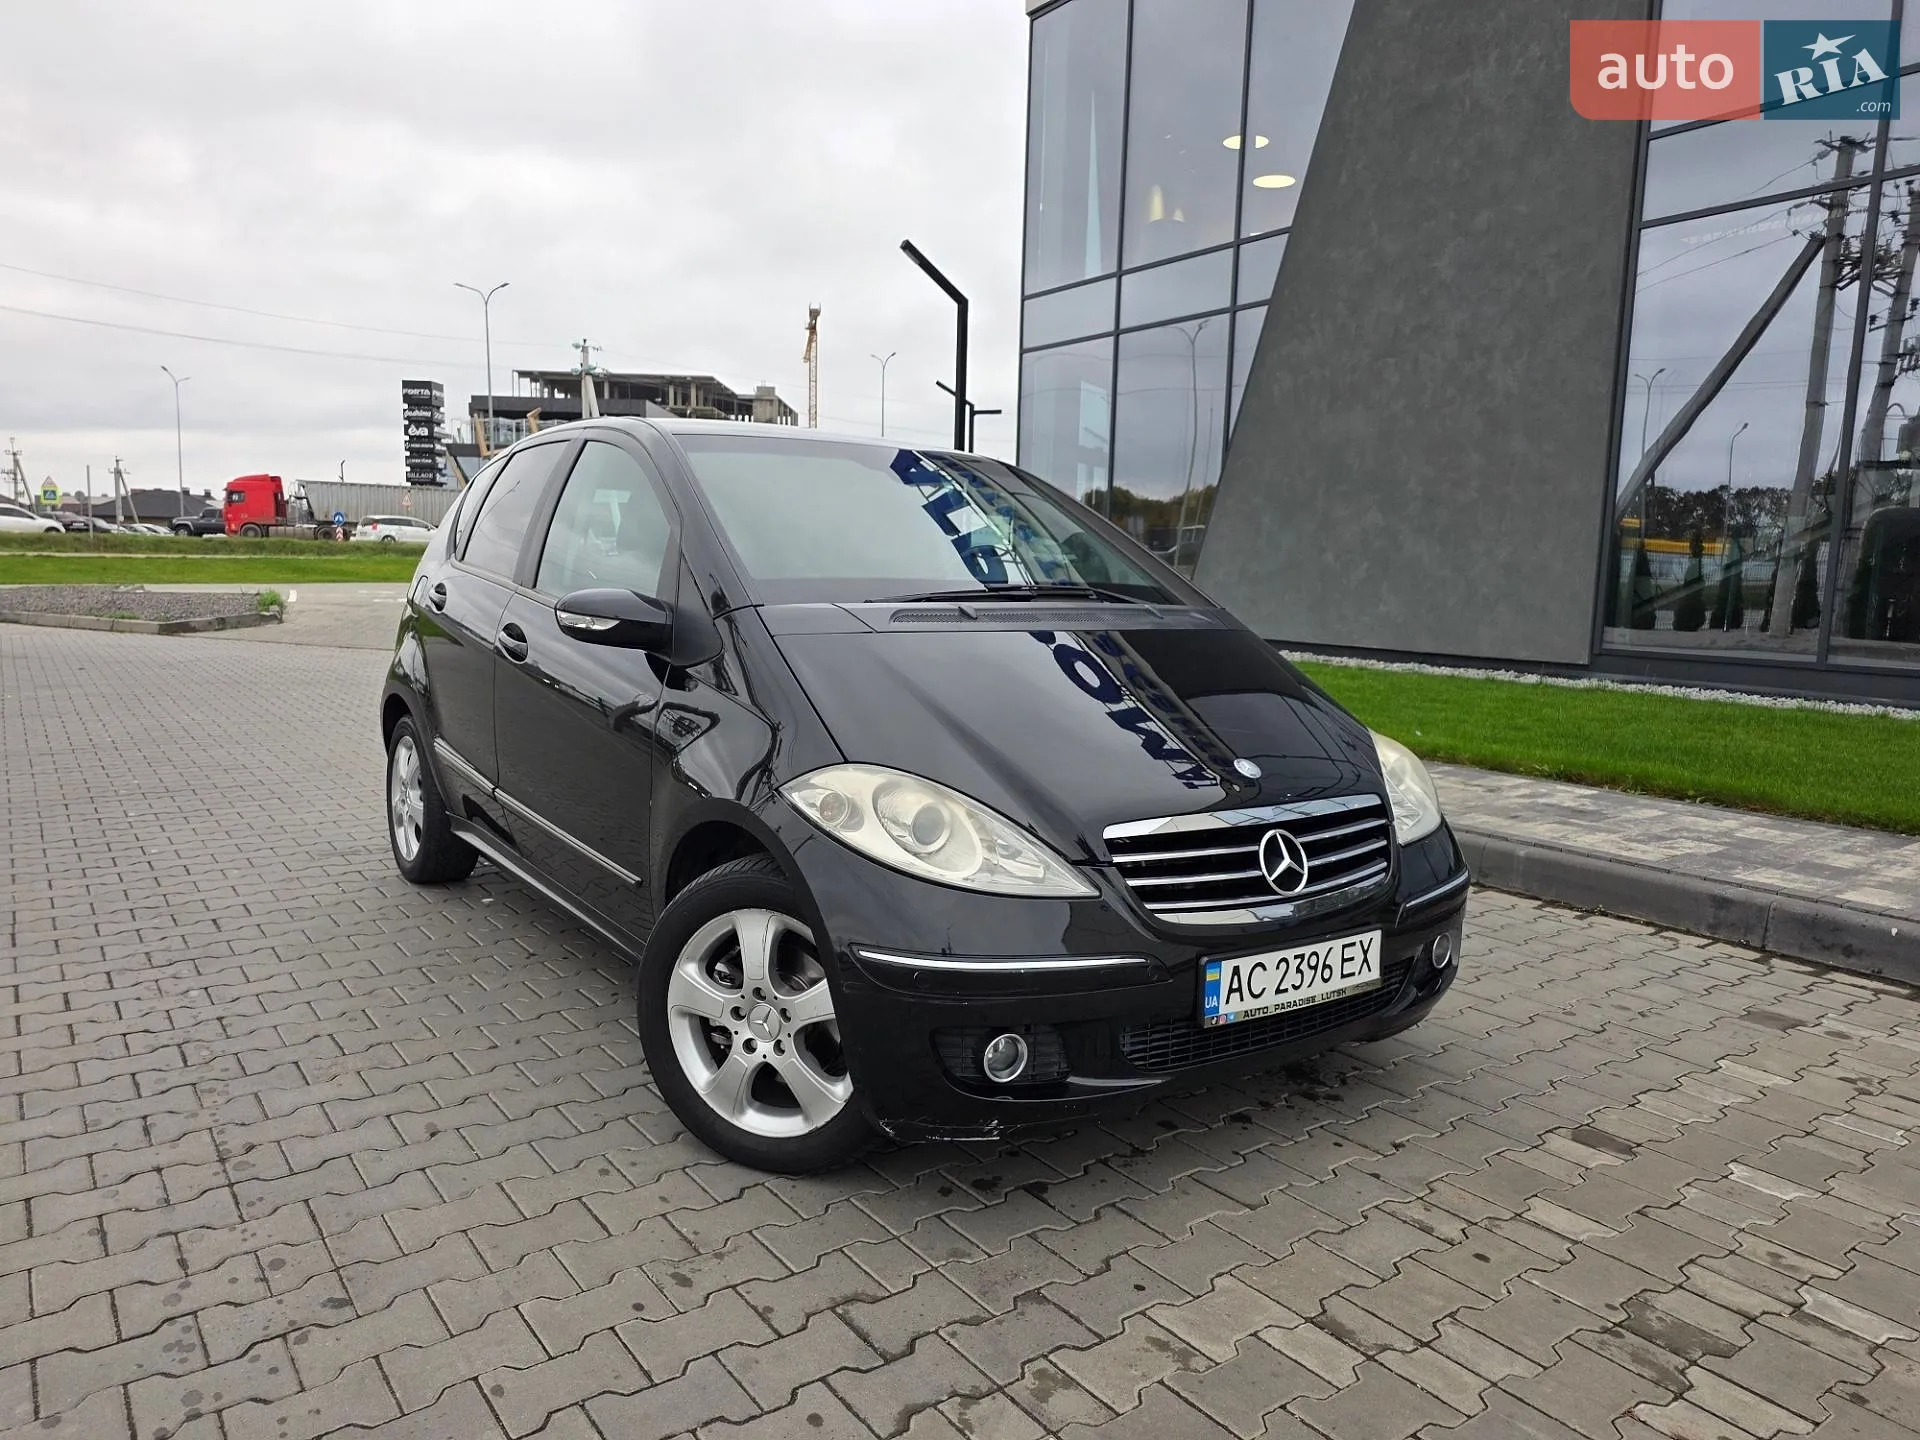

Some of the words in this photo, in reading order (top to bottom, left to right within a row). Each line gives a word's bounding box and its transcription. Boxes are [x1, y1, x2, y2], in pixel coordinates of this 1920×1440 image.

[1225, 962, 1267, 1005] AC
[1275, 946, 1333, 996] 2396
[1340, 937, 1374, 979] EX
[1205, 995, 1218, 1009] UA
